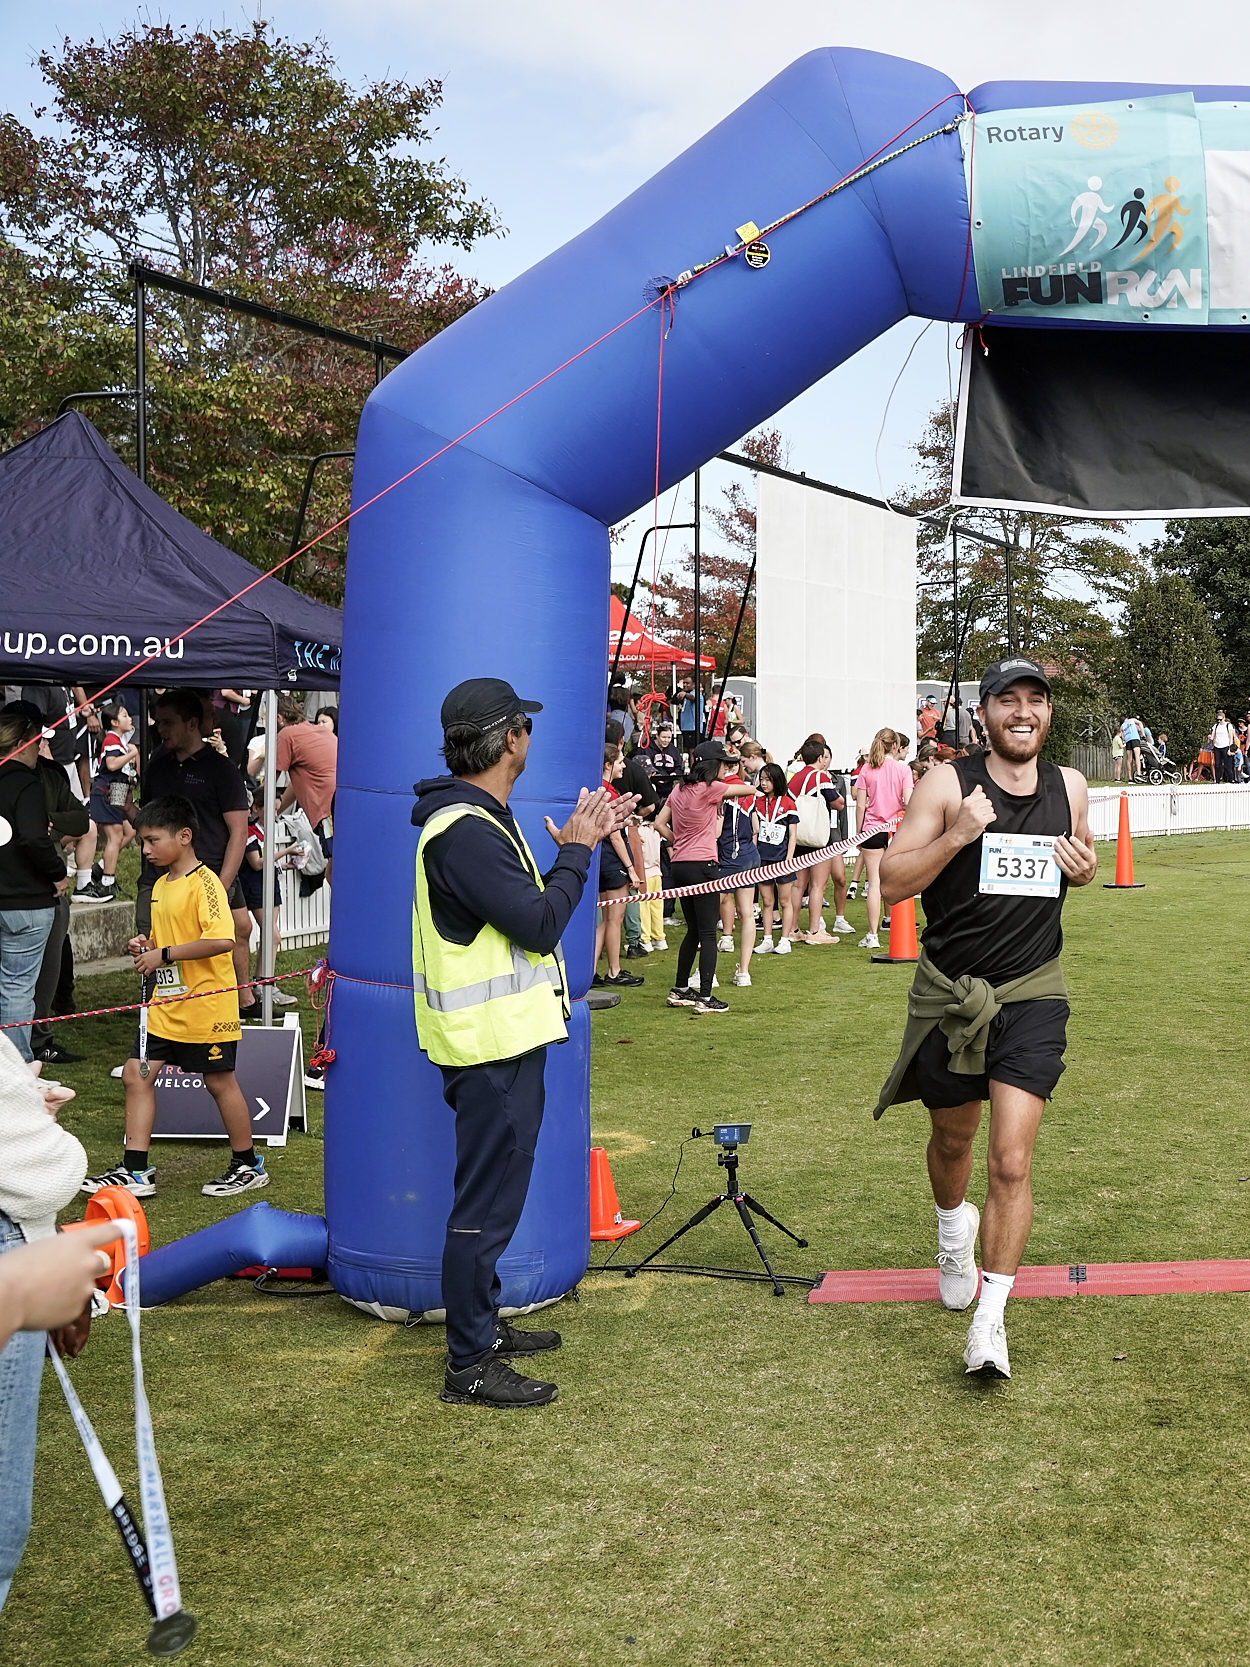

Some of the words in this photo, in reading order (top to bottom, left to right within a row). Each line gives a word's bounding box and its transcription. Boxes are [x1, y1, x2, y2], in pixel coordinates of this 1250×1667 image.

[986, 125, 1064, 144] Rotary
[1001, 261, 1102, 279] LINDFIELD
[0, 632, 184, 660] up.com.au
[763, 830, 779, 839] 505
[997, 857, 1048, 879] 5337
[154, 1078, 207, 1089] WELCO
[146, 1470, 171, 1571] MARSHALL
[112, 1503, 148, 1569] BRIDGE
